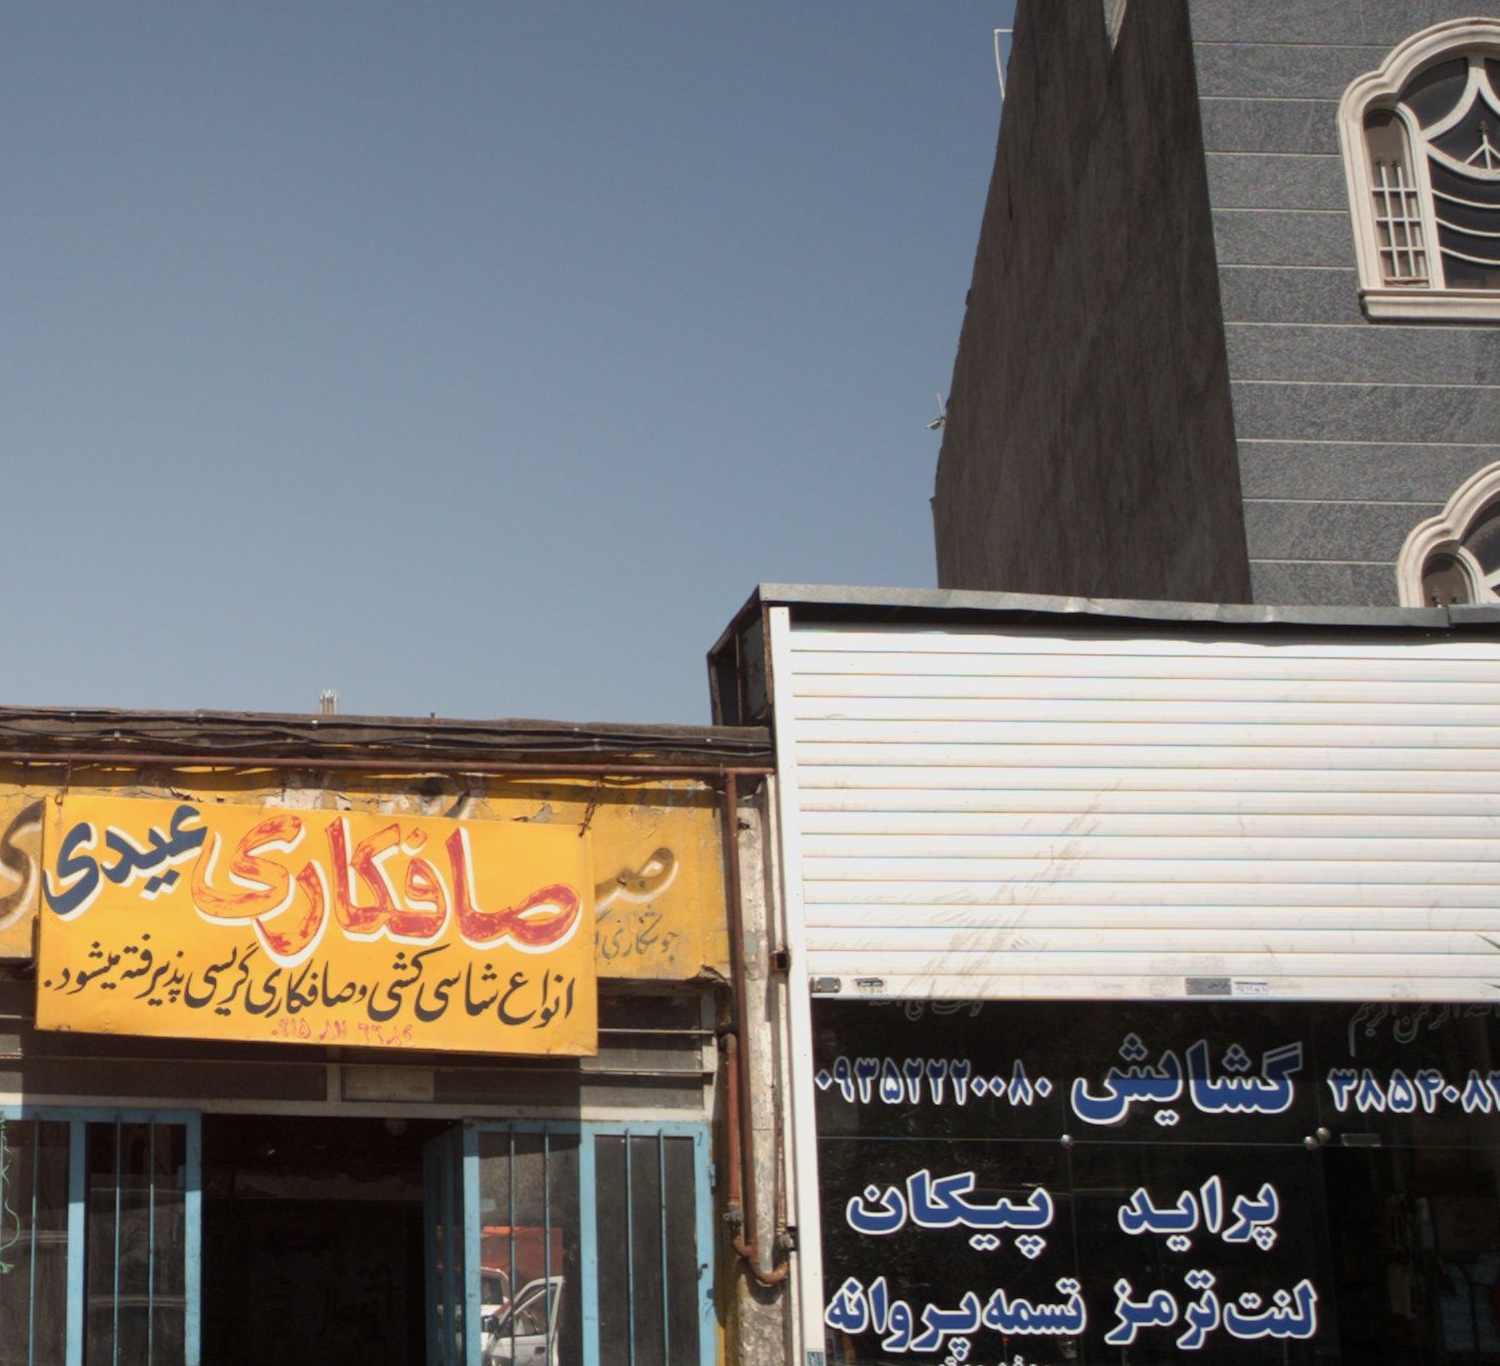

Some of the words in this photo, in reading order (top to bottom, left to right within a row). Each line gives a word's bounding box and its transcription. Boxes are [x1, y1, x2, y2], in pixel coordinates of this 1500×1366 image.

[41, 804, 209, 922] عیدی
[190, 814, 582, 968] صافکاری
[367, 943, 451, 1022] کشی
[414, 962, 499, 1022] شاسی
[497, 968, 576, 1029] انواع
[1070, 1033, 1302, 1125] گشایش
[845, 1170, 1054, 1258] پیکان
[1118, 1174, 1280, 1250] پراید
[824, 1276, 982, 1361] پروانه
[982, 1278, 1087, 1335] تسمه
[1105, 1268, 1221, 1349] ترمز
[1223, 1278, 1320, 1339] لنت
